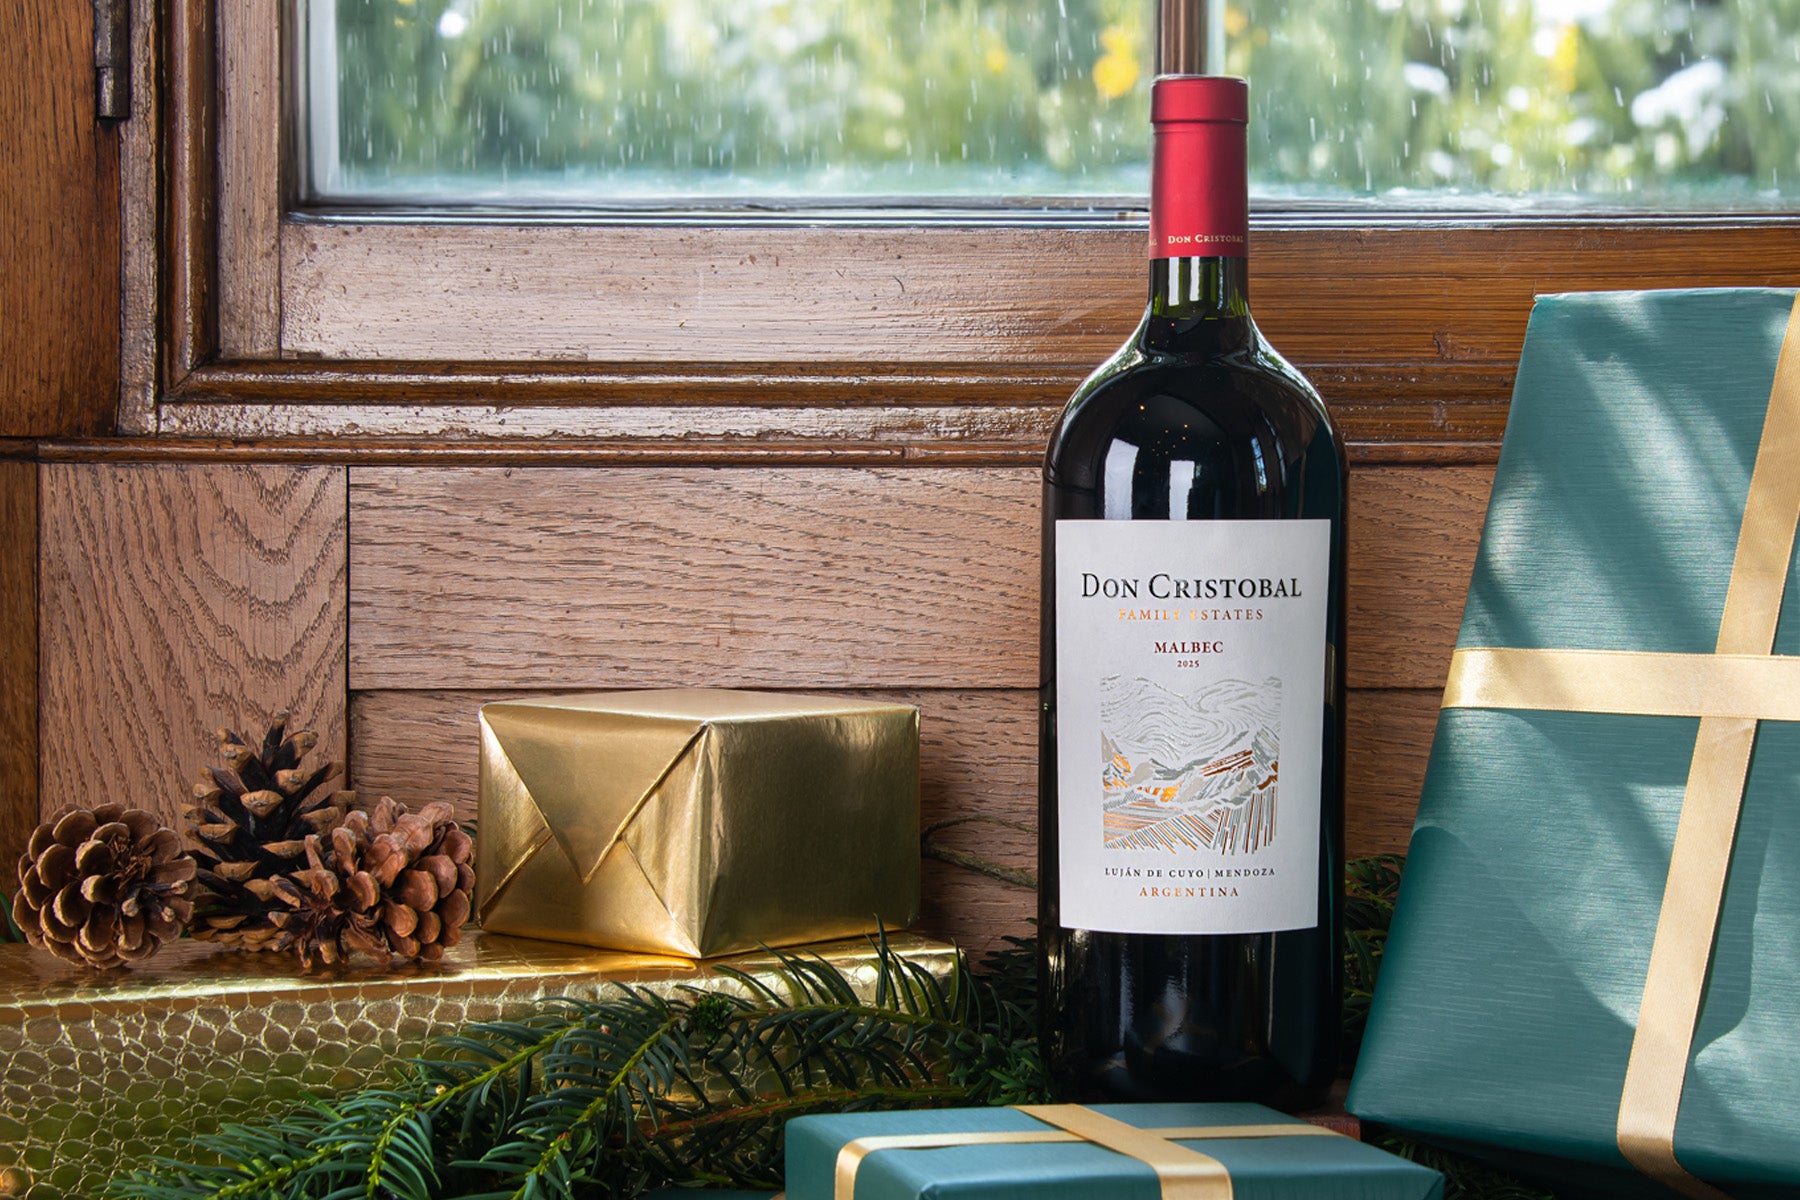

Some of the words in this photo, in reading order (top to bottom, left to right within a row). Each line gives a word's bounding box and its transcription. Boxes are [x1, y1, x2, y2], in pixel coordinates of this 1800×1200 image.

[1167, 235, 1191, 244] DON
[1082, 573, 1139, 599] DON
[1149, 573, 1302, 599] CRISTOBAL
[1119, 608, 1182, 621] FAMILY
[1190, 608, 1264, 621] ESTATES
[1154, 641, 1224, 654] MALBEC
[1177, 660, 1200, 668] 2025
[1105, 867, 1141, 878] LUJÁN
[1147, 869, 1163, 878] DE
[1169, 870, 1204, 878] CUYO
[1215, 868, 1276, 877] MENDOZA
[1139, 886, 1240, 897] ARGENTINA
